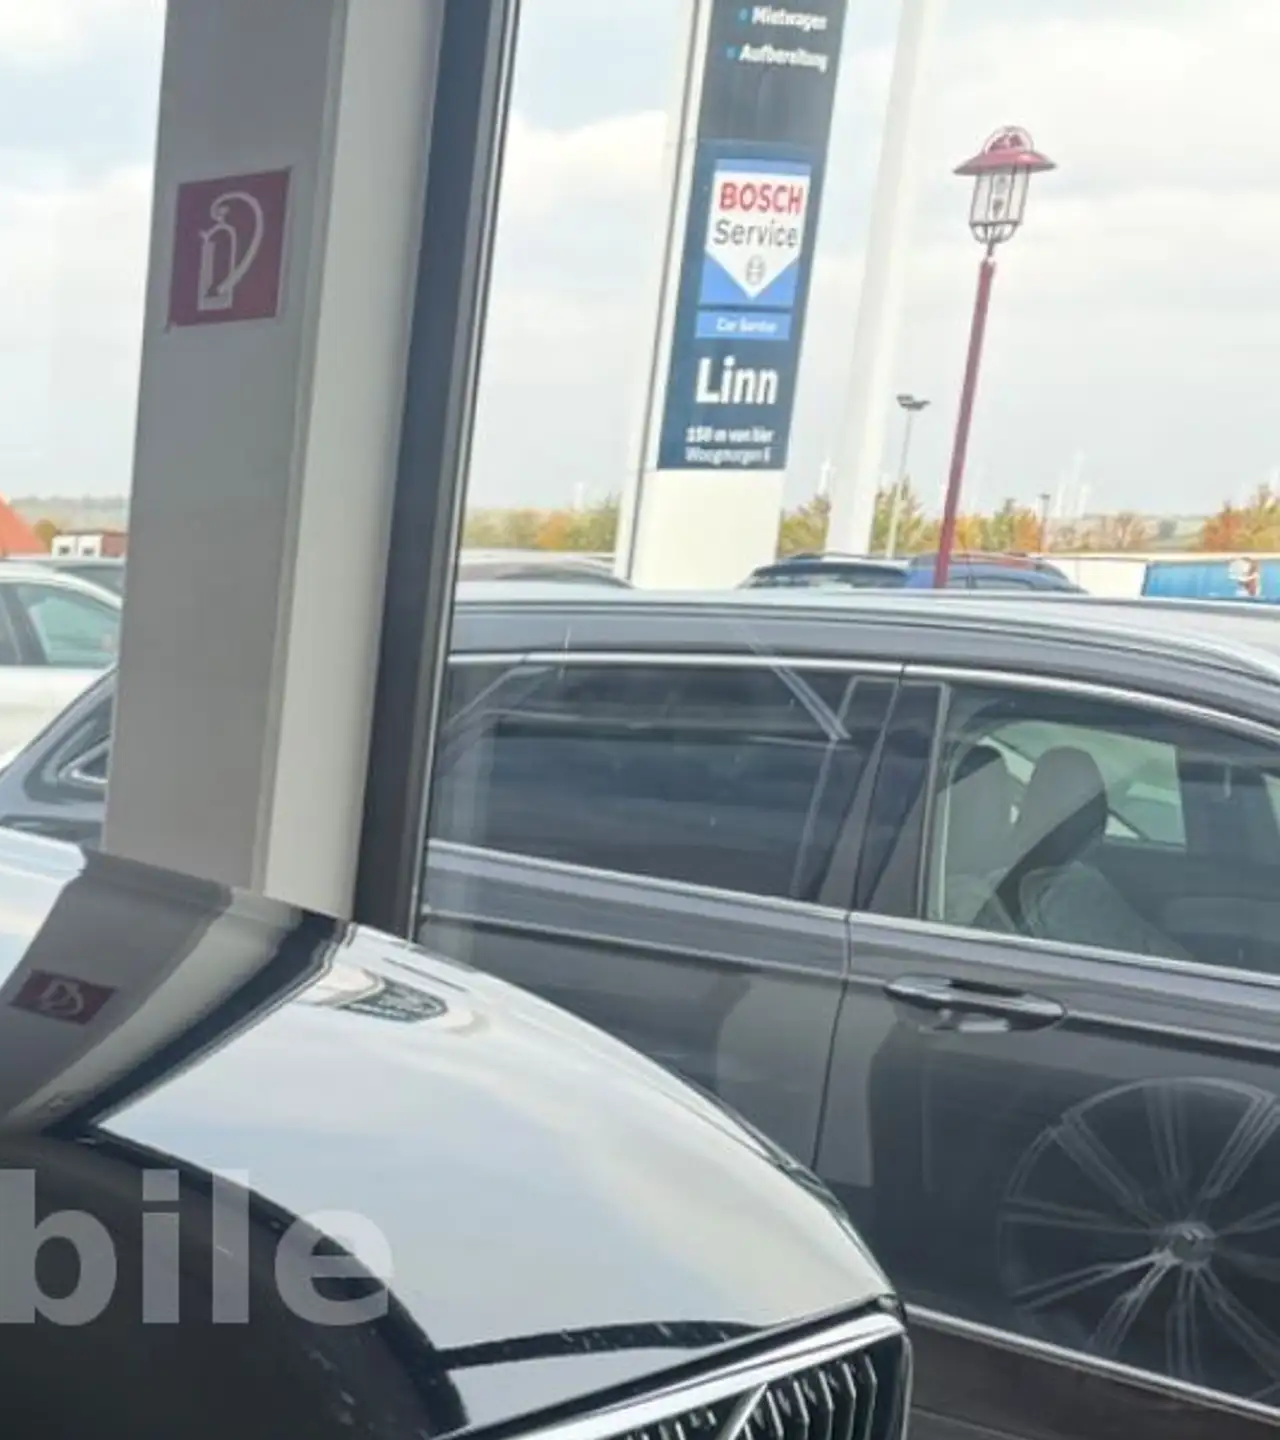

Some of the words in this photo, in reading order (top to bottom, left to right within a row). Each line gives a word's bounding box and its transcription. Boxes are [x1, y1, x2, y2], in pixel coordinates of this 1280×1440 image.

[751, 4, 827, 32] Mietwagen
[739, 43, 828, 73] Aufbereitung
[719, 182, 803, 215] BOSCH
[712, 217, 798, 247] Service
[695, 355, 778, 405] Linn
